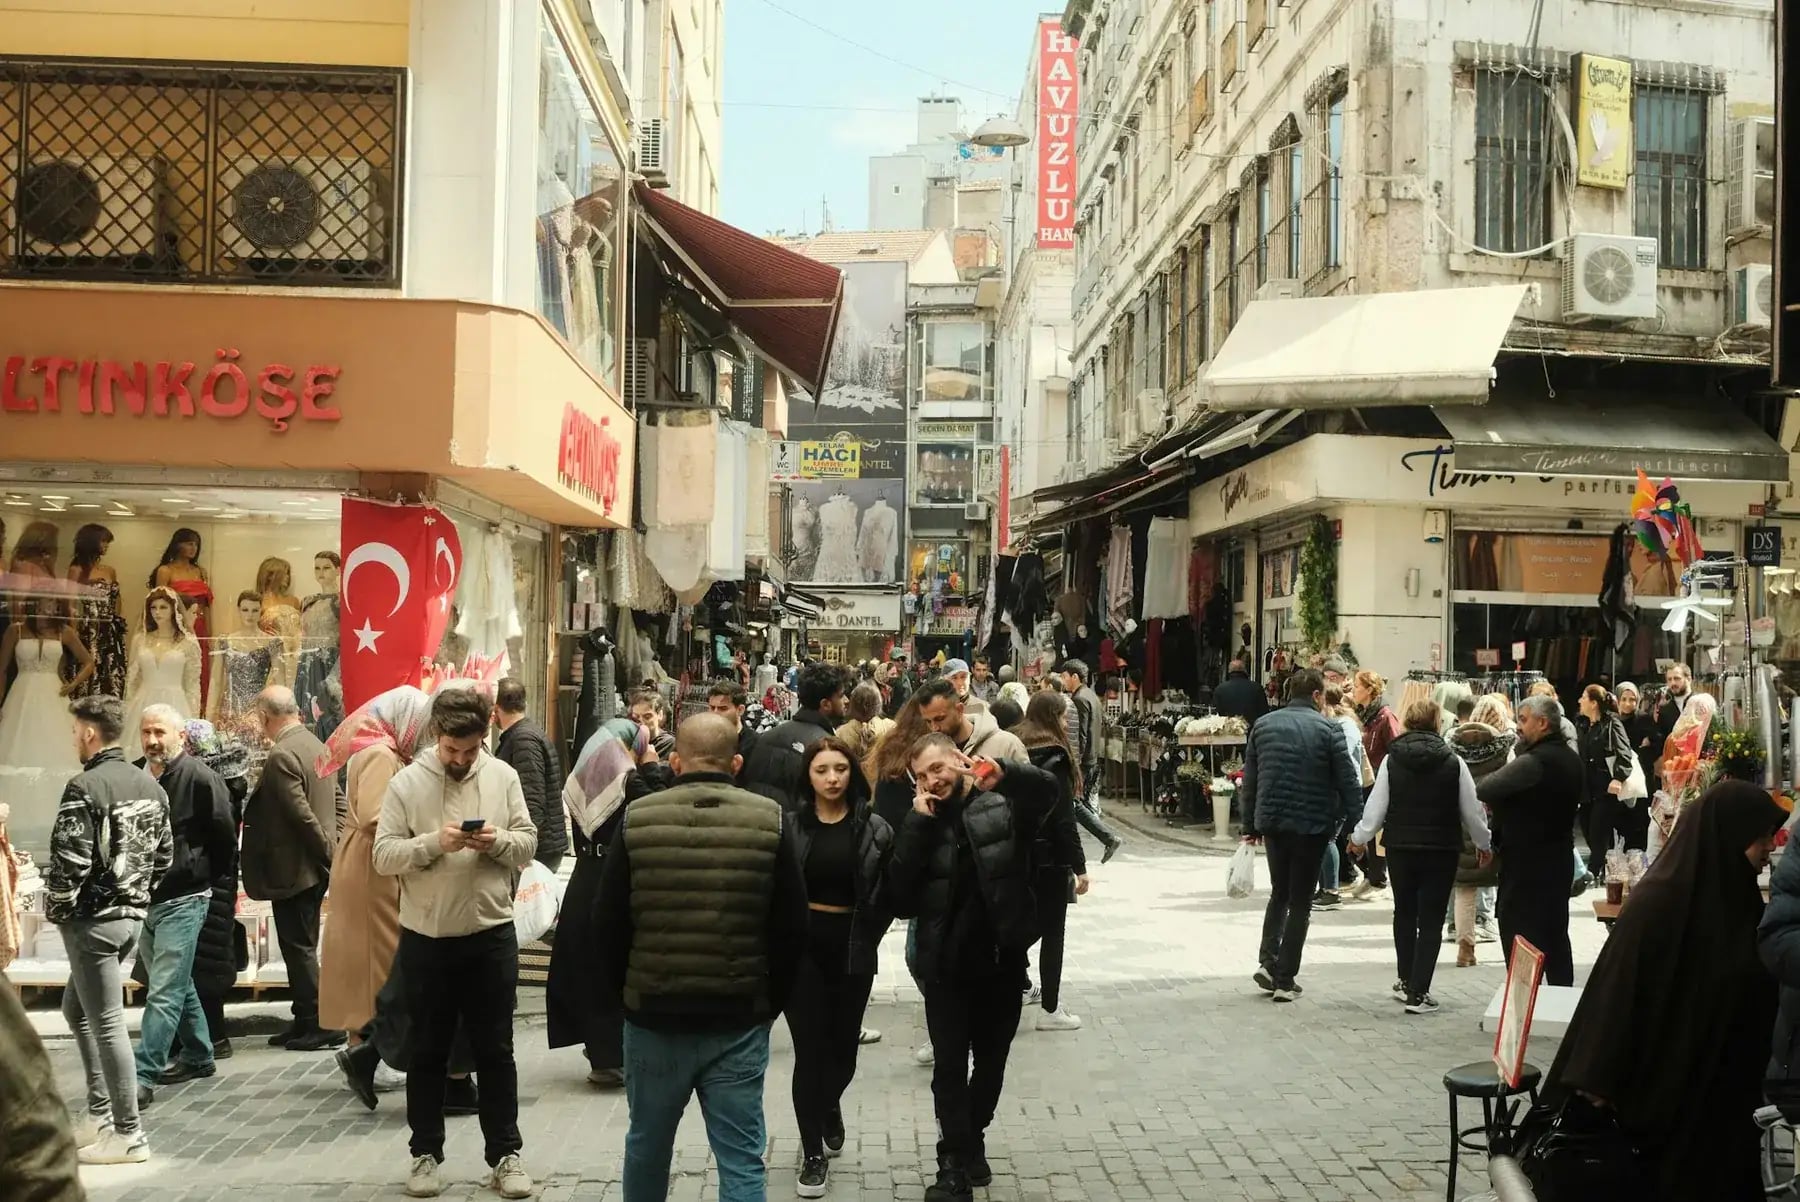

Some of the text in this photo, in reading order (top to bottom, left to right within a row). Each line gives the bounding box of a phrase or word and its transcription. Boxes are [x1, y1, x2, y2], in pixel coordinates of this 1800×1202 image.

[1046, 30, 1073, 220] HAVUZLU
[1040, 227, 1074, 242] HAN
[803, 447, 857, 462] HACI
[776, 461, 790, 469] WC
[860, 460, 894, 470] ANTEL
[1752, 532, 1774, 550] D'S
[836, 613, 884, 627] DANTEL
